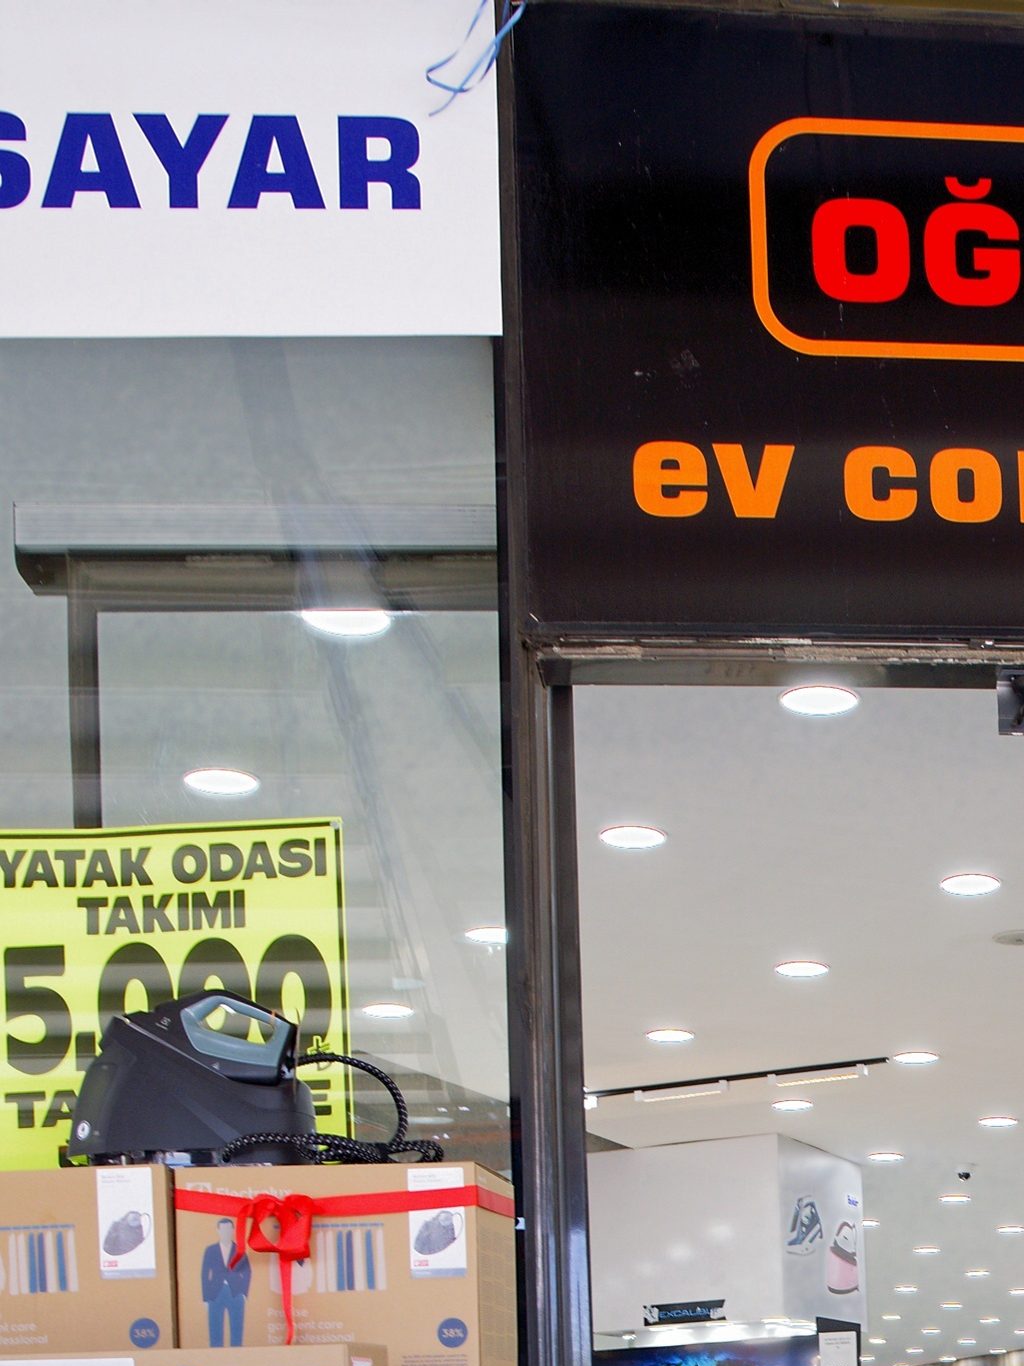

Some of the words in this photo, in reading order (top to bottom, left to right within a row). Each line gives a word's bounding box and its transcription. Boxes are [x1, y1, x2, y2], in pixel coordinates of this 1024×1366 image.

[632, 440, 795, 519] ev
[0, 846, 153, 889] YATAK
[172, 837, 327, 884] ODASI
[77, 889, 247, 936] TAKIMI
